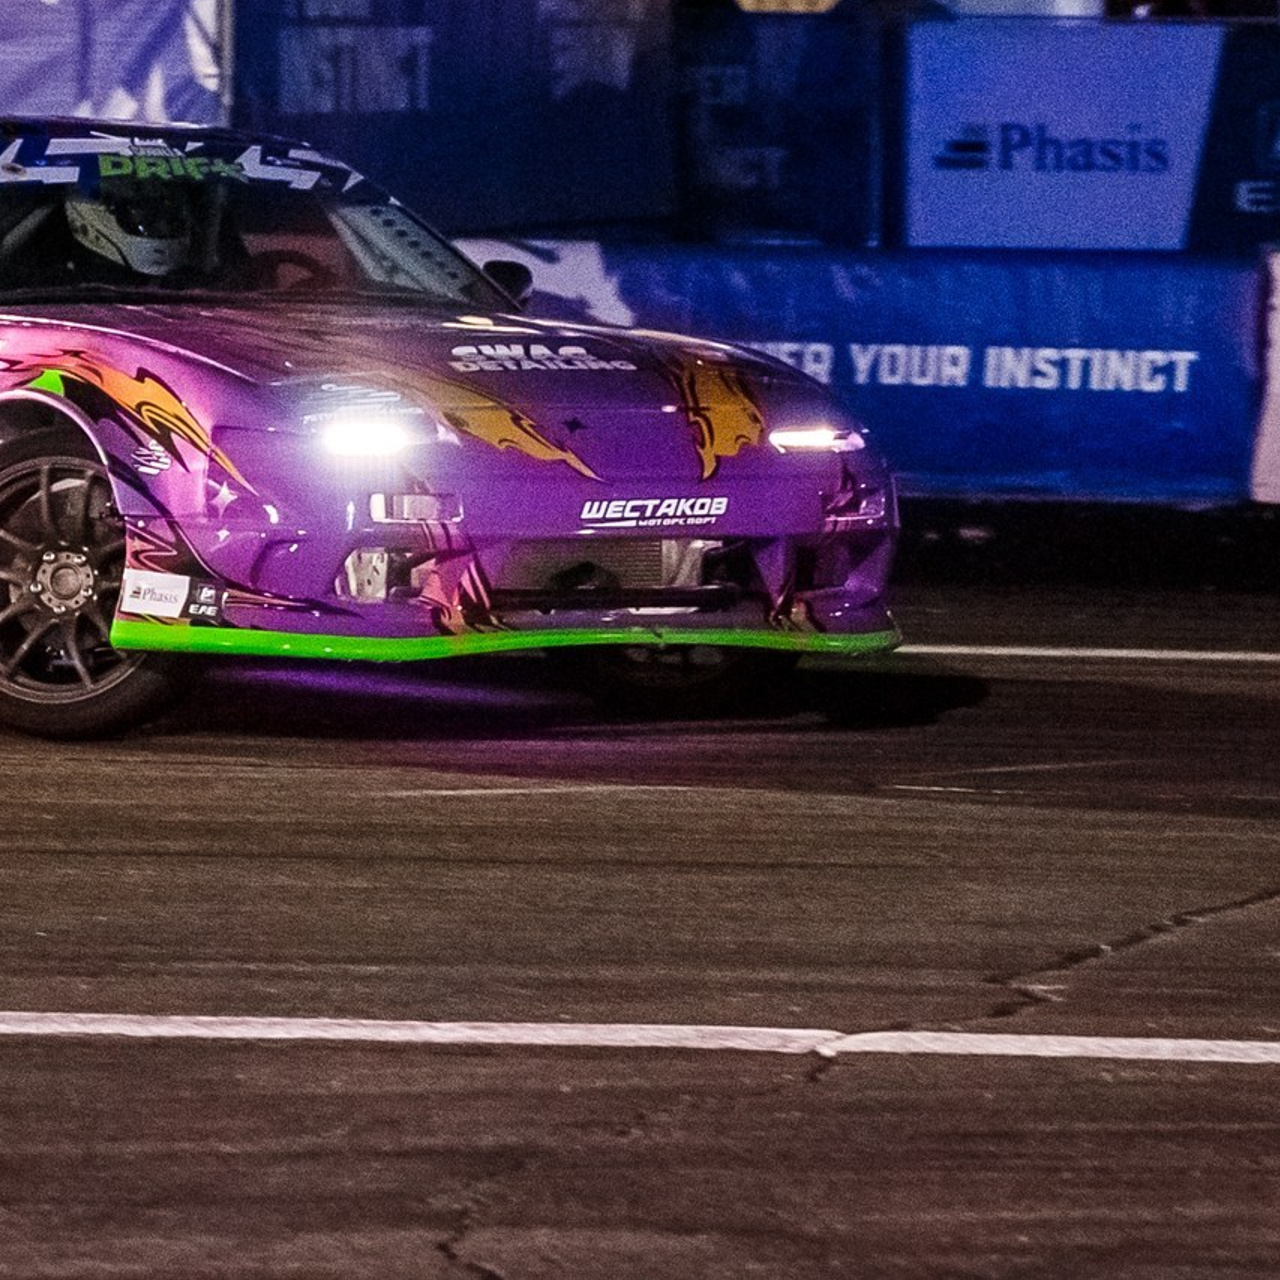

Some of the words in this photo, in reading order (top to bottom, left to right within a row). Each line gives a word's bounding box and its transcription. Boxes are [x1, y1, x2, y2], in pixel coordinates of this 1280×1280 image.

[999, 123, 1169, 173] Phasis
[849, 343, 971, 387] YOUR
[983, 345, 1199, 393] INSTINCT
[580, 497, 729, 519] ШЕСТАКОВ
[141, 587, 179, 604] Phasis
